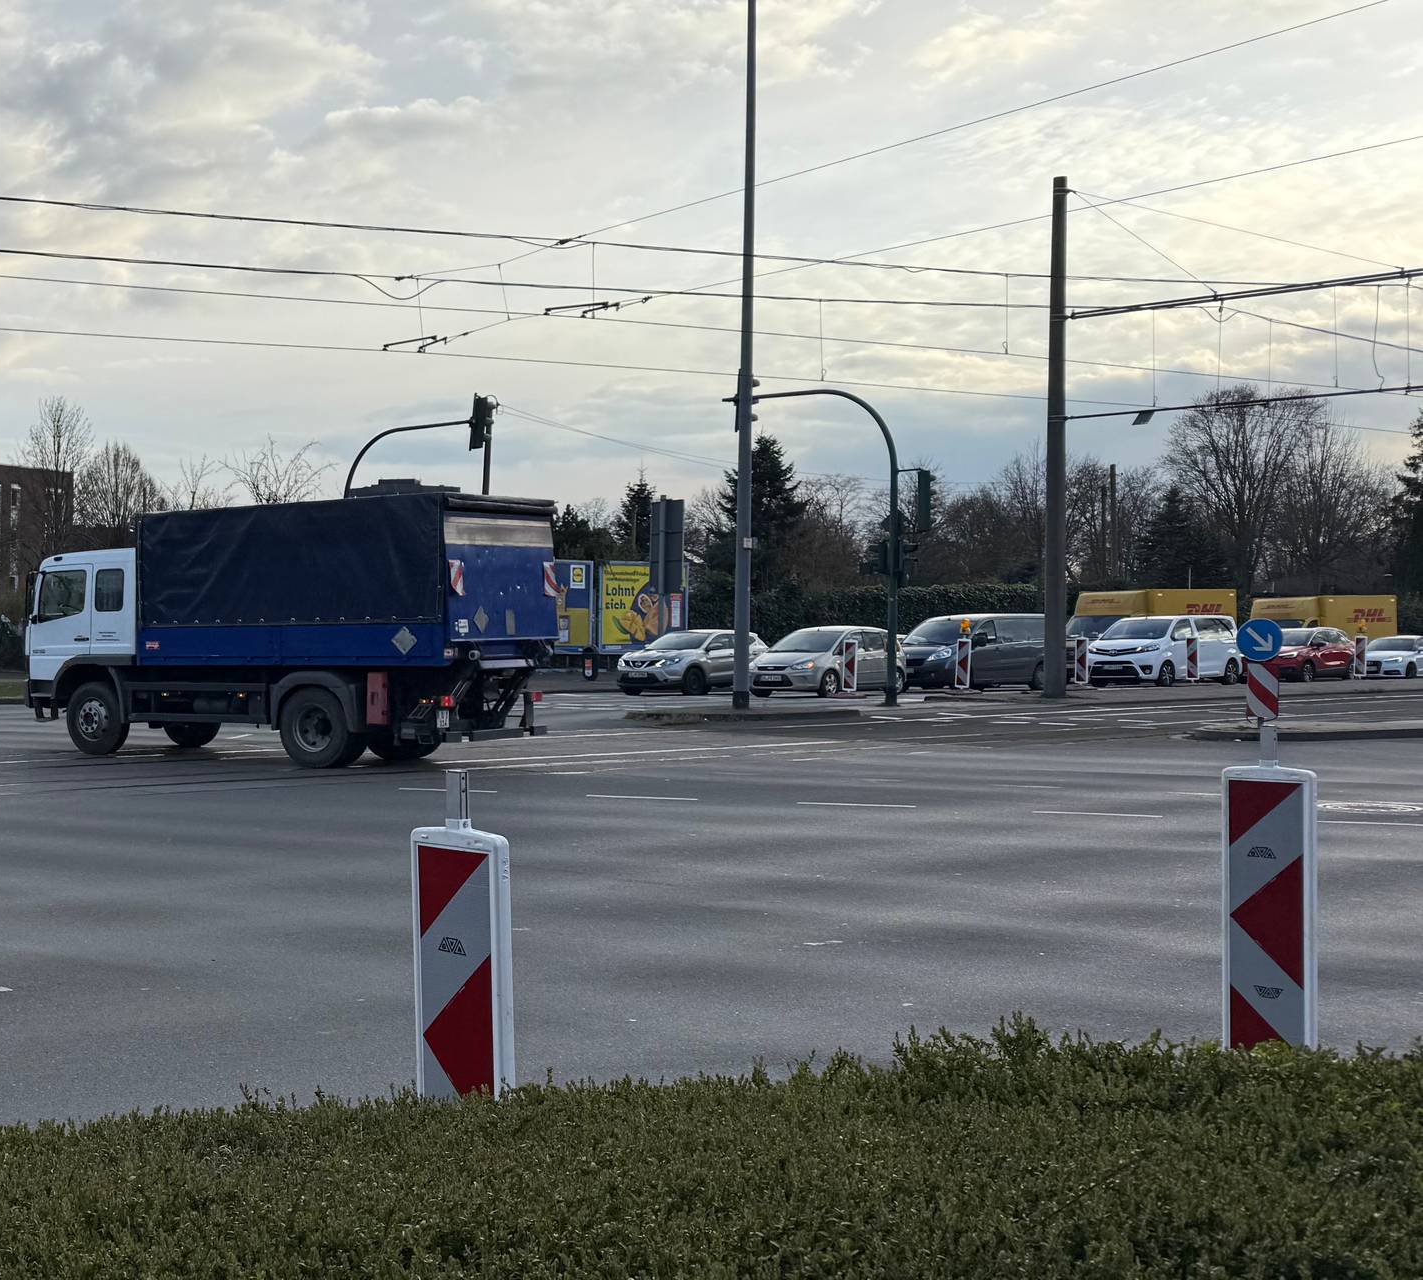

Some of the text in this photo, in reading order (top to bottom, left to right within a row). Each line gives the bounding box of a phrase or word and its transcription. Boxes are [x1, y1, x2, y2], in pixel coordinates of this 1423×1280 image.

[605, 583, 635, 597] Lohnt
[605, 599, 626, 610] sich
[1353, 608, 1385, 623] DHL
